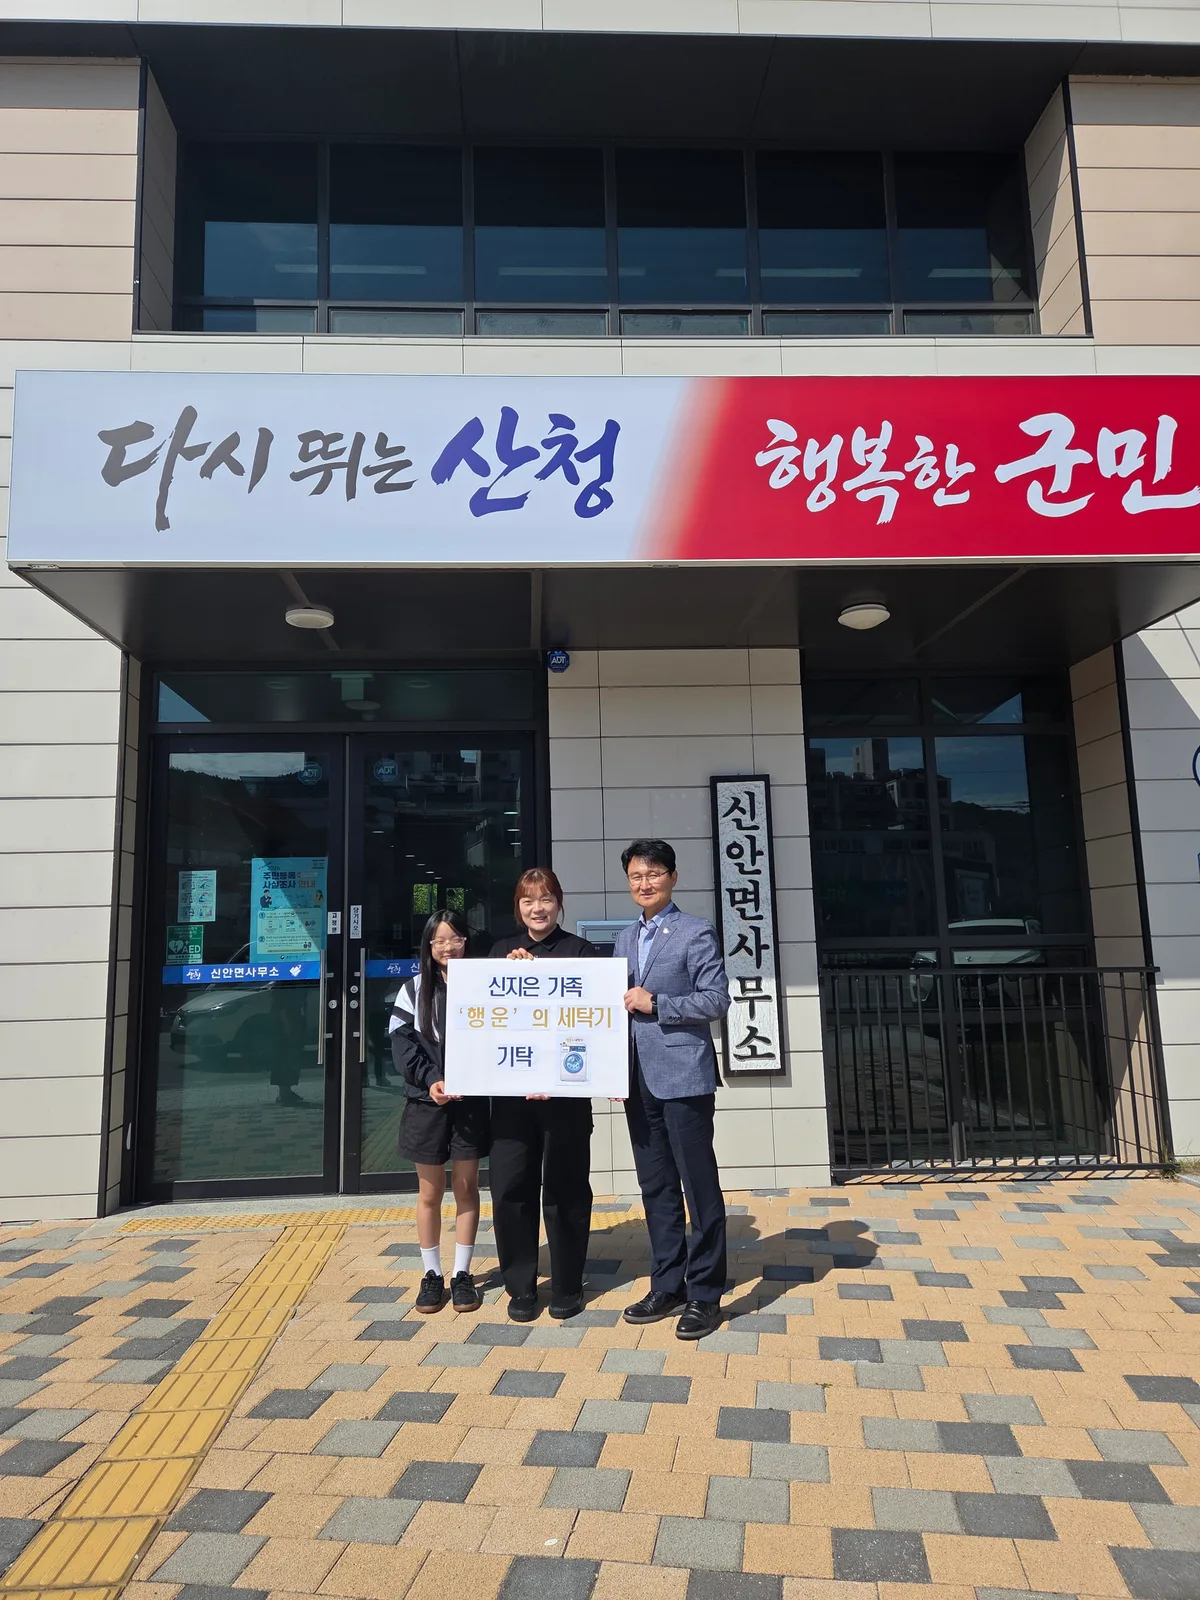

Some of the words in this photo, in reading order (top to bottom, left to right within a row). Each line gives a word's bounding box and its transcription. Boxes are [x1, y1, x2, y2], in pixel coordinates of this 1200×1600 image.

[97, 405, 273, 533] 다시
[289, 429, 418, 502] 뛰는
[430, 405, 621, 518] 산청
[755, 418, 976, 525] 행복한
[994, 412, 1200, 518] 군민
[550, 656, 566, 664] ADT
[302, 769, 318, 777] ADT
[377, 766, 394, 774] ADT
[263, 871, 296, 880] 주민등록
[263, 879, 296, 889] 사실조사
[298, 879, 316, 888] 안내
[722, 790, 776, 1062] 신안면사무소
[182, 944, 201, 954] AED
[210, 967, 279, 979] 신안면사무소
[488, 976, 540, 998] 신지은
[547, 976, 583, 998] 가족
[532, 1008, 549, 1028] 의
[557, 1006, 612, 1029] 세탁기
[497, 1046, 534, 1068] 기탁
